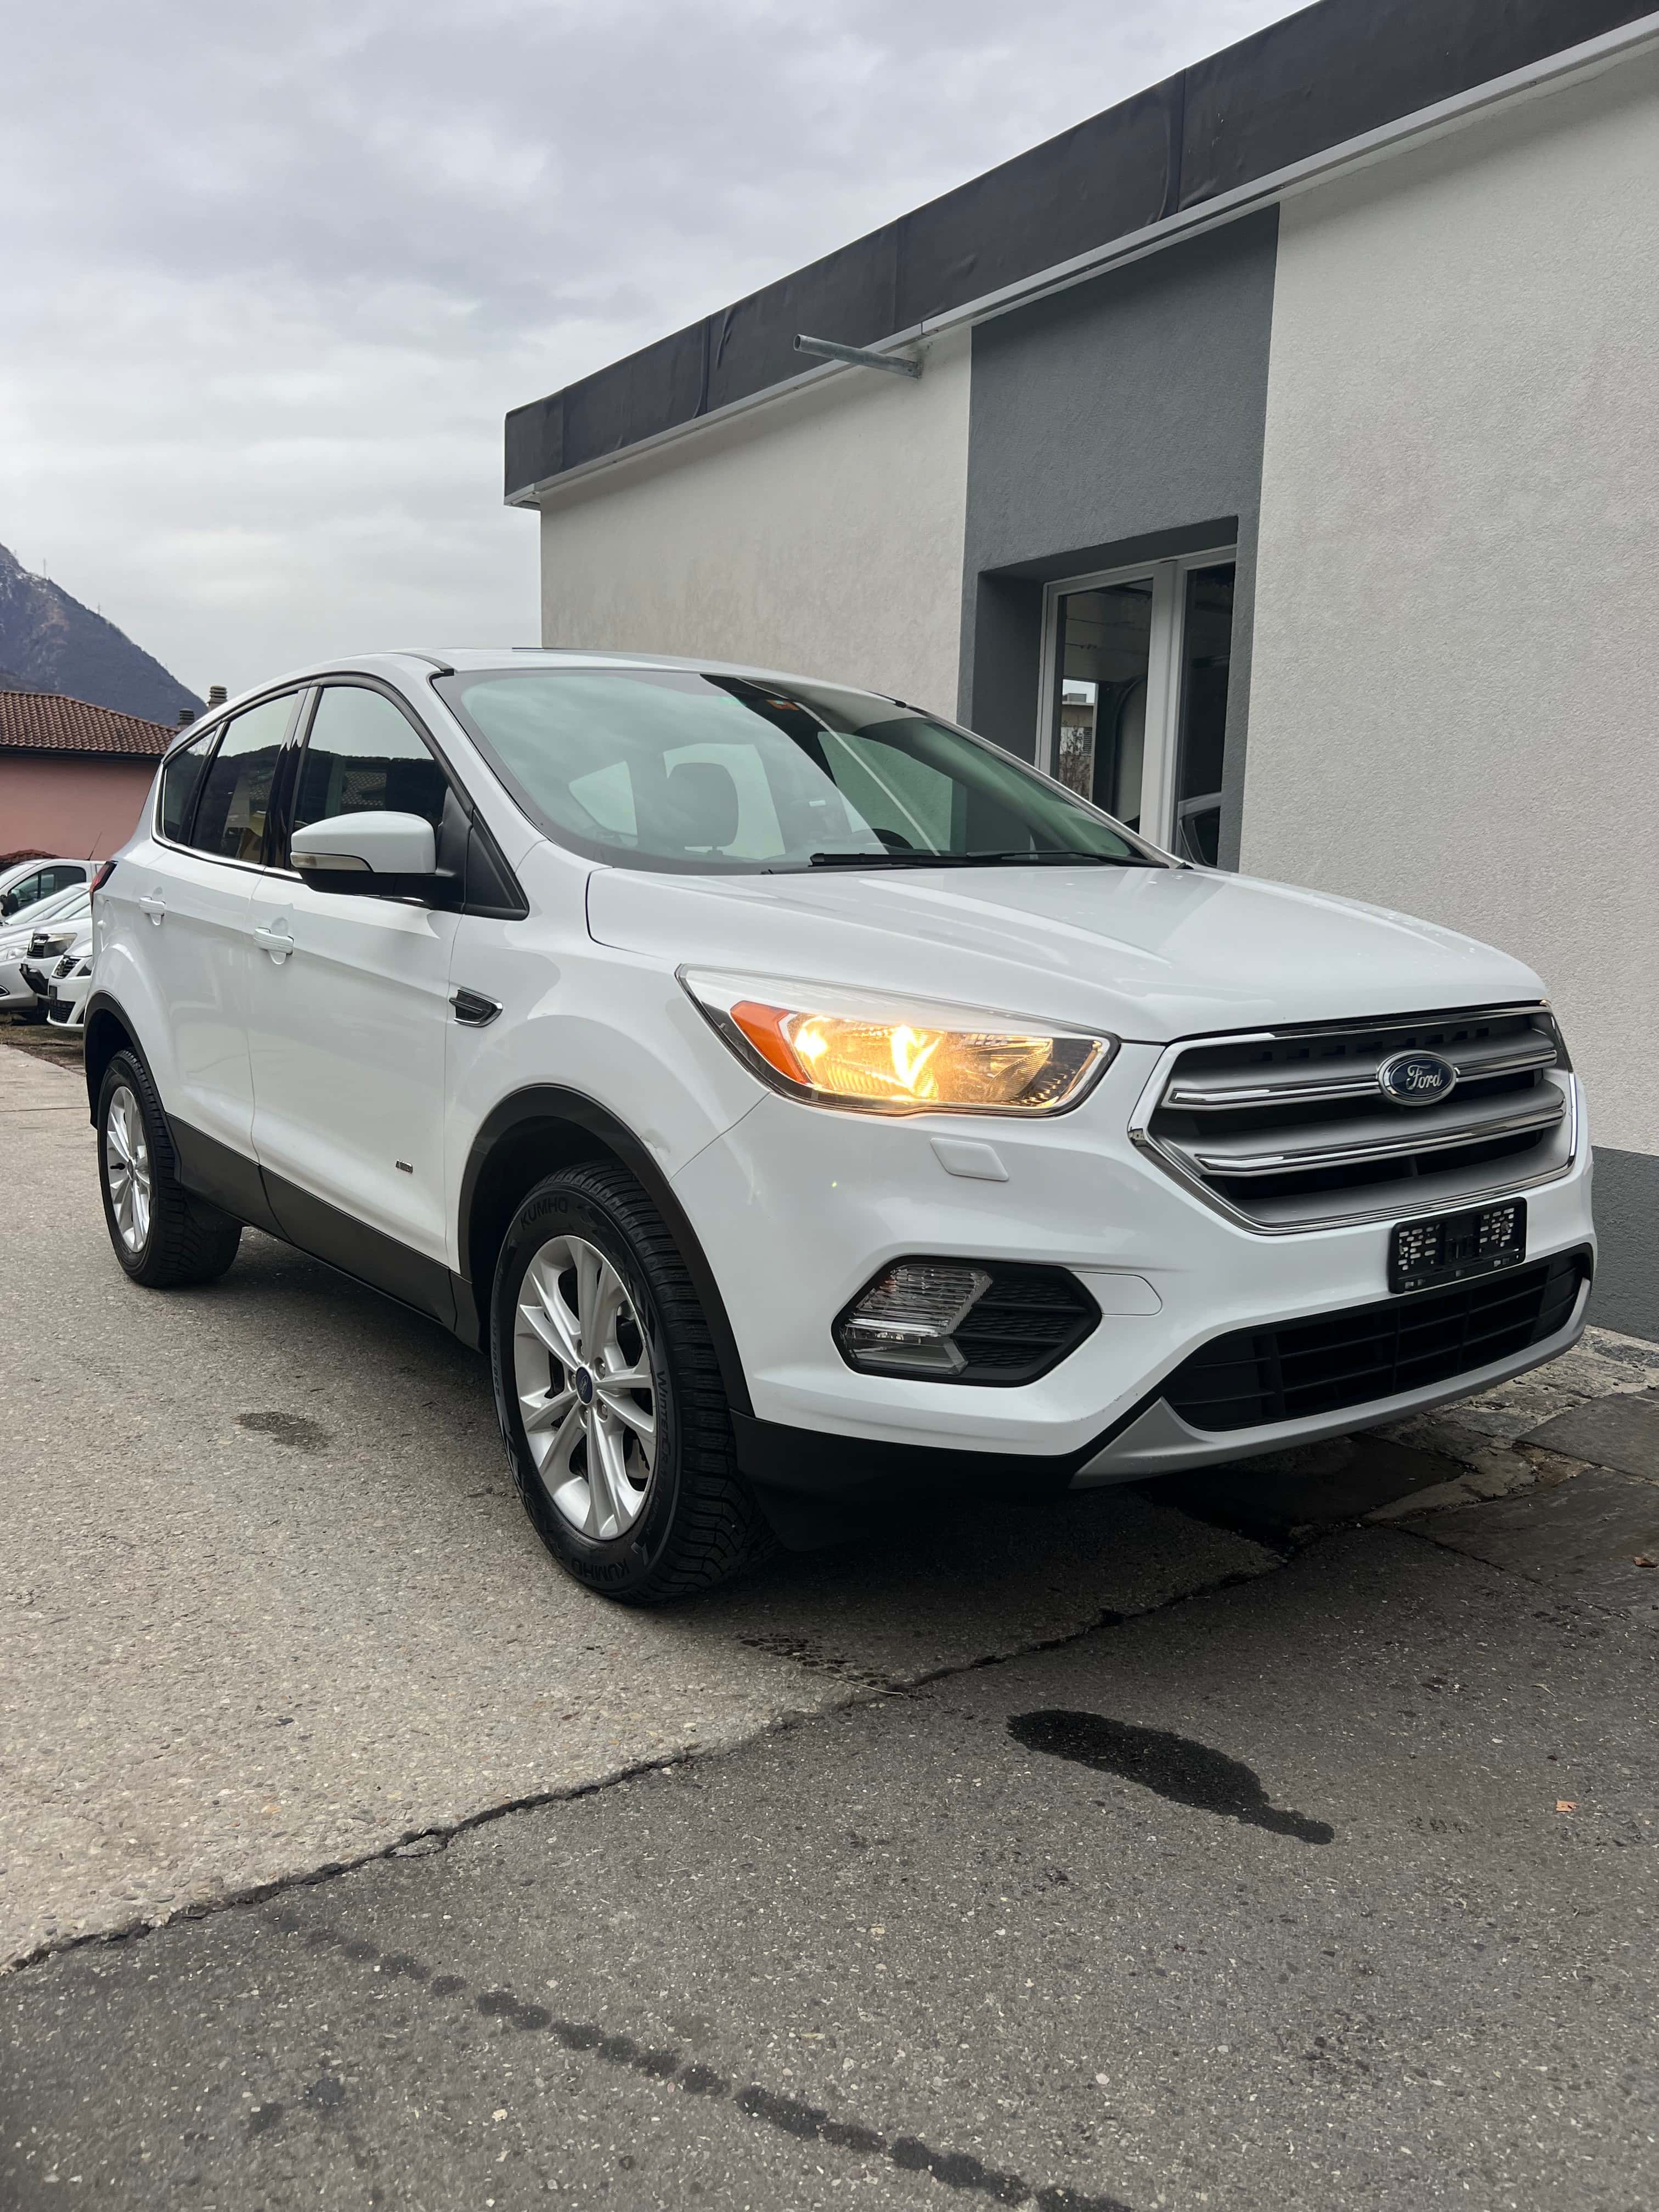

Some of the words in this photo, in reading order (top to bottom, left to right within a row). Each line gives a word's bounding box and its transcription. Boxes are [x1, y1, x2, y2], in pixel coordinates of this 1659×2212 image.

[1406, 1064, 1442, 1090] Ford
[520, 1197, 567, 1231] KUMHO
[571, 1558, 629, 1581] KUMHO
